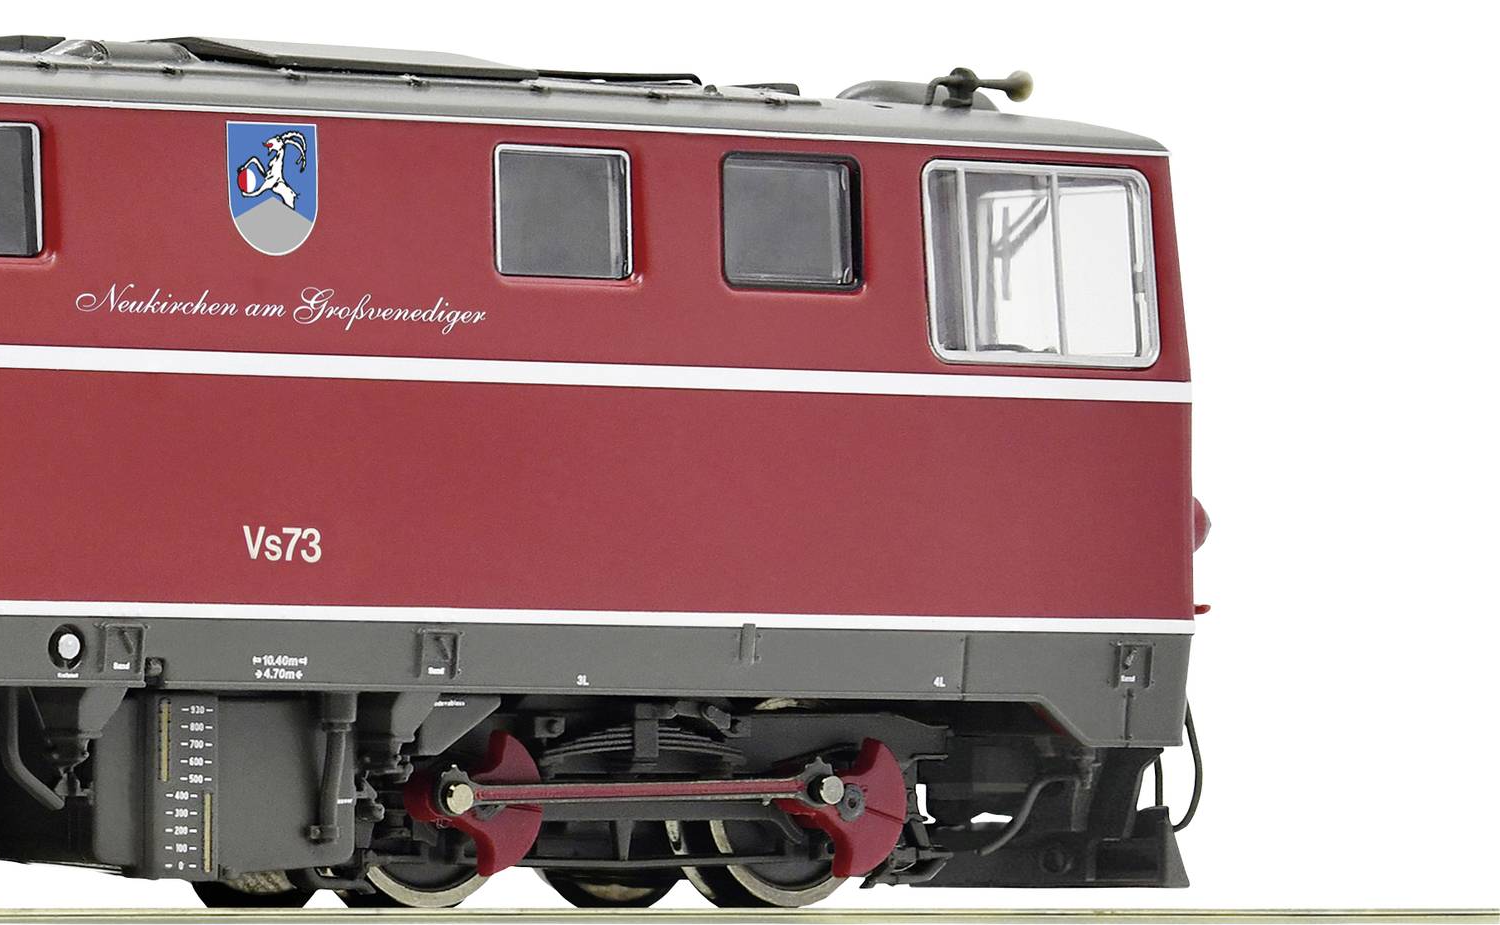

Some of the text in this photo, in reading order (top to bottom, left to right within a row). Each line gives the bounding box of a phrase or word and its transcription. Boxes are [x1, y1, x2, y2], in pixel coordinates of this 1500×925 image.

[75, 283, 486, 335] Neukirchen am Großvenediger
[242, 525, 322, 563] Vs73
[263, 667, 295, 679] 4.70m
[576, 674, 590, 686] 3L
[933, 676, 947, 688] 4L
[189, 722, 204, 731] 800
[189, 739, 204, 749] 700
[189, 756, 204, 766] 600
[188, 773, 203, 784] 500
[174, 790, 189, 800] 400
[174, 808, 188, 818] 300
[174, 825, 188, 835] 200
[175, 843, 188, 853] 100
